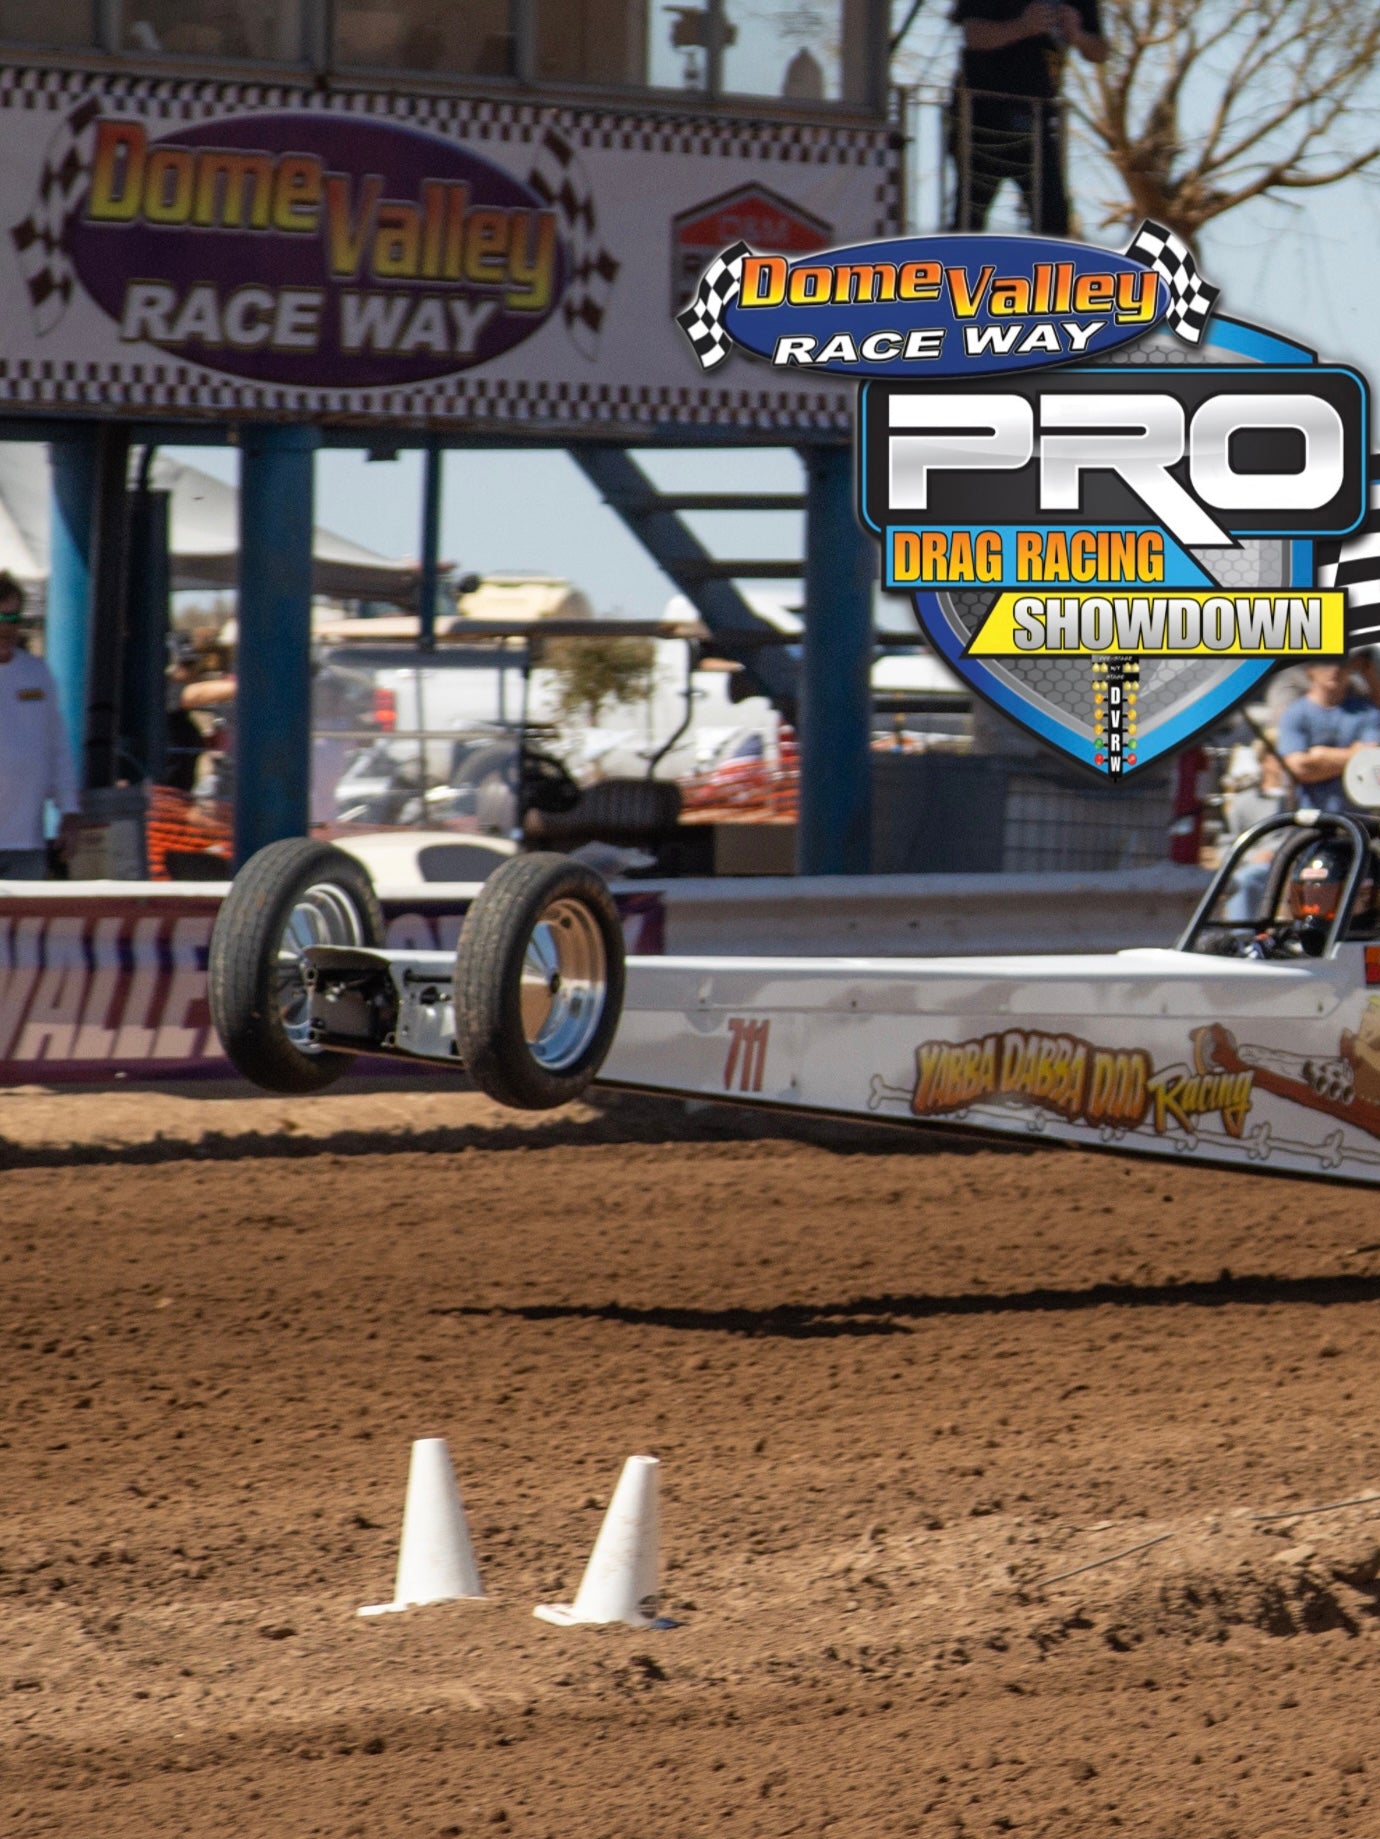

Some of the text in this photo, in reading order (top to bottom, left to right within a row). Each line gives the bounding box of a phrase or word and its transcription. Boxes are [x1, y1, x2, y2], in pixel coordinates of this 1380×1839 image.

[86, 120, 556, 312] Dome Valley
[120, 280, 499, 355] RACE WAY
[0, 916, 225, 1060] VALLE
[723, 1017, 770, 1092] 711
[914, 1041, 998, 1113] YABBA
[999, 1029, 1087, 1120] DABBA
[1149, 1063, 1254, 1138] Racing
